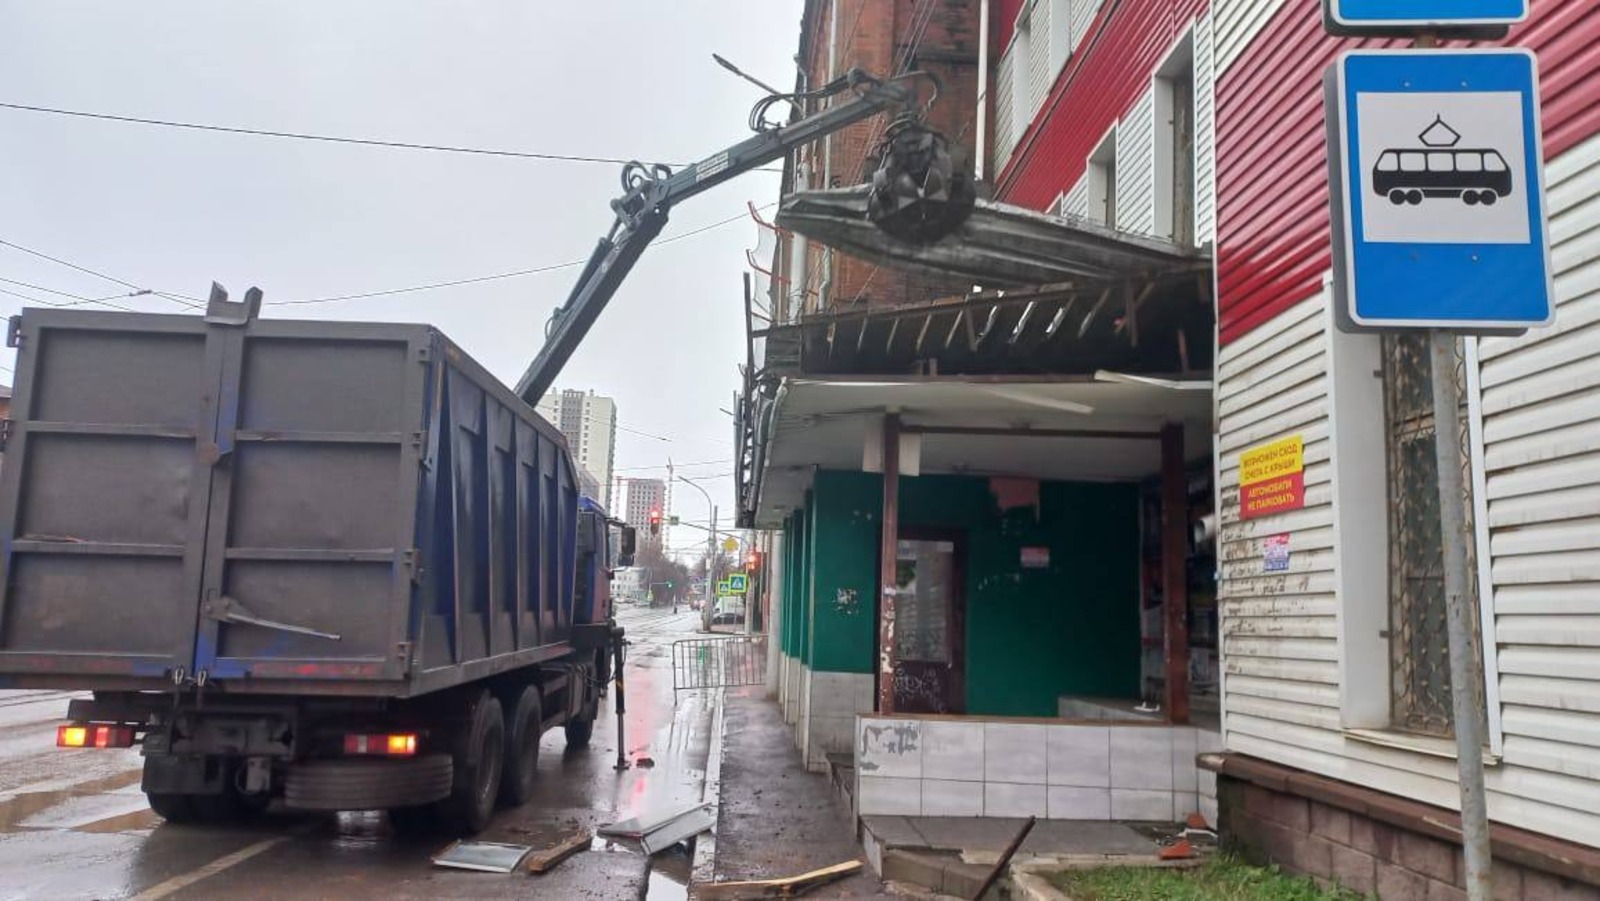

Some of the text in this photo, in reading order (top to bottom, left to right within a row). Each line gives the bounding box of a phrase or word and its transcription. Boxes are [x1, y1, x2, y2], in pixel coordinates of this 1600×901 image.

[1279, 443, 1298, 456] СХОД
[1248, 479, 1292, 498] АВТОМОБИЛИ
[1248, 492, 1295, 511] НЕ ПАРКОВАТЬ
